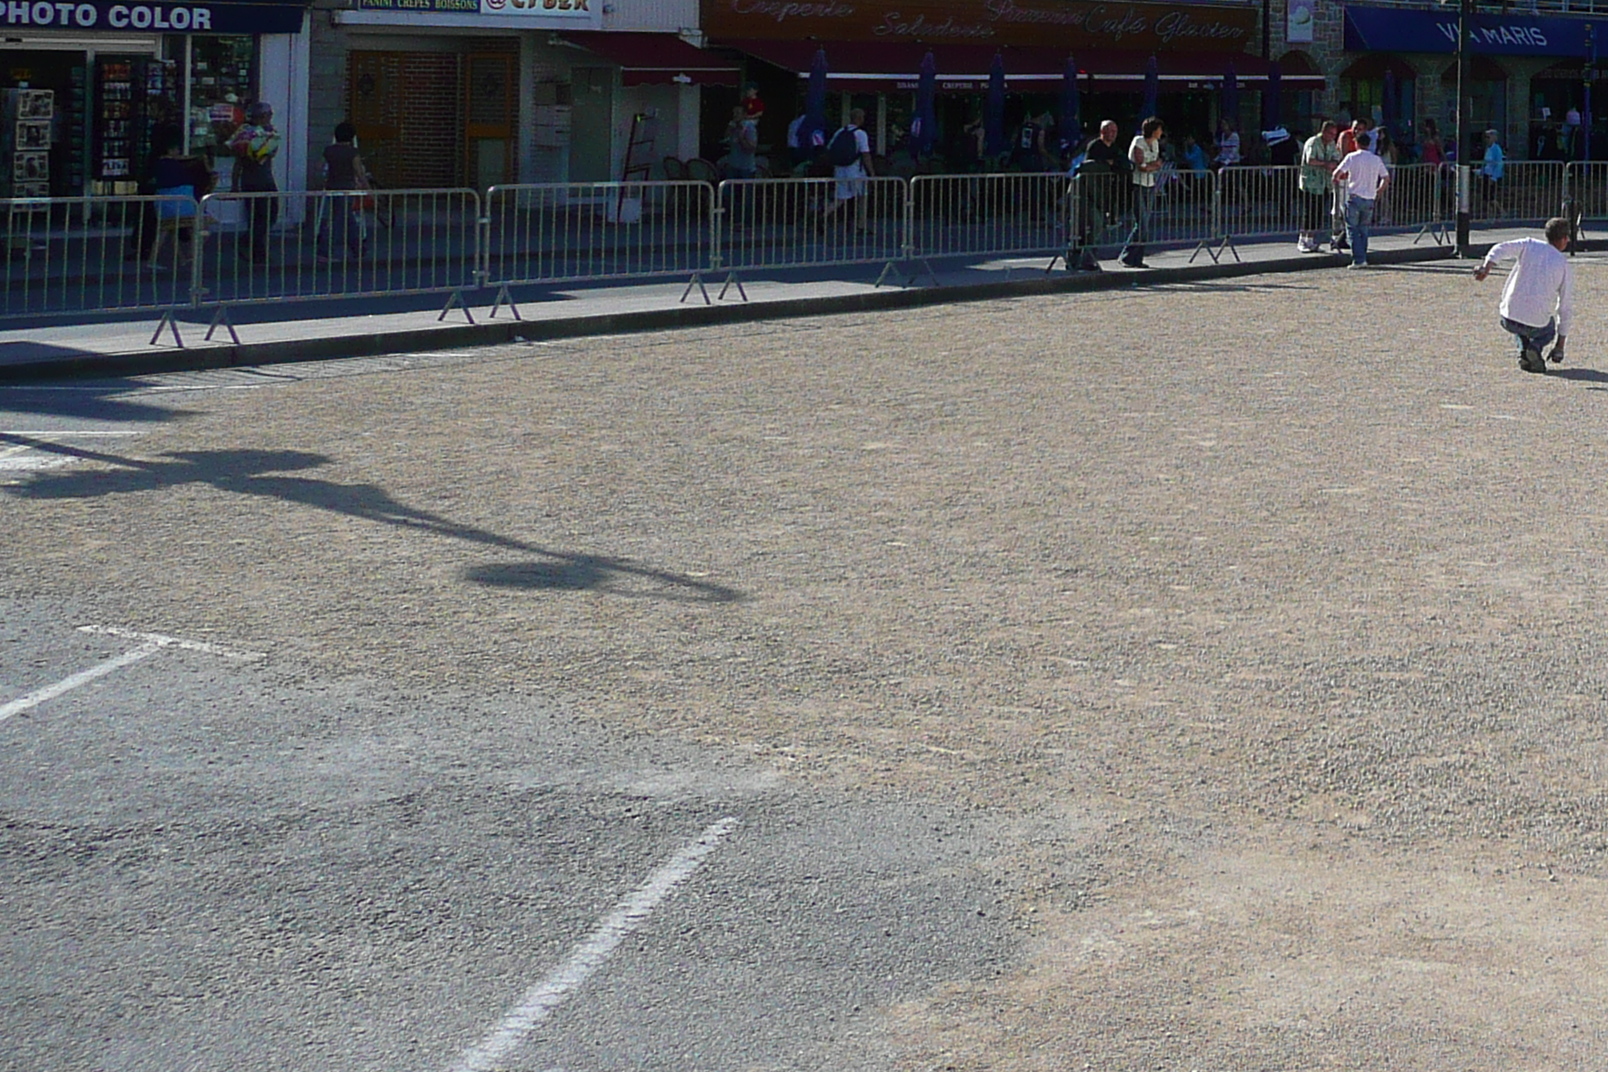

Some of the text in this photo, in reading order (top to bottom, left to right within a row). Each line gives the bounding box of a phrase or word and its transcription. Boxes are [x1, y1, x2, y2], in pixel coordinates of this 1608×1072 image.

[0, 0, 212, 29] HOTO COLOR
[1480, 26, 1548, 47] MARIS
